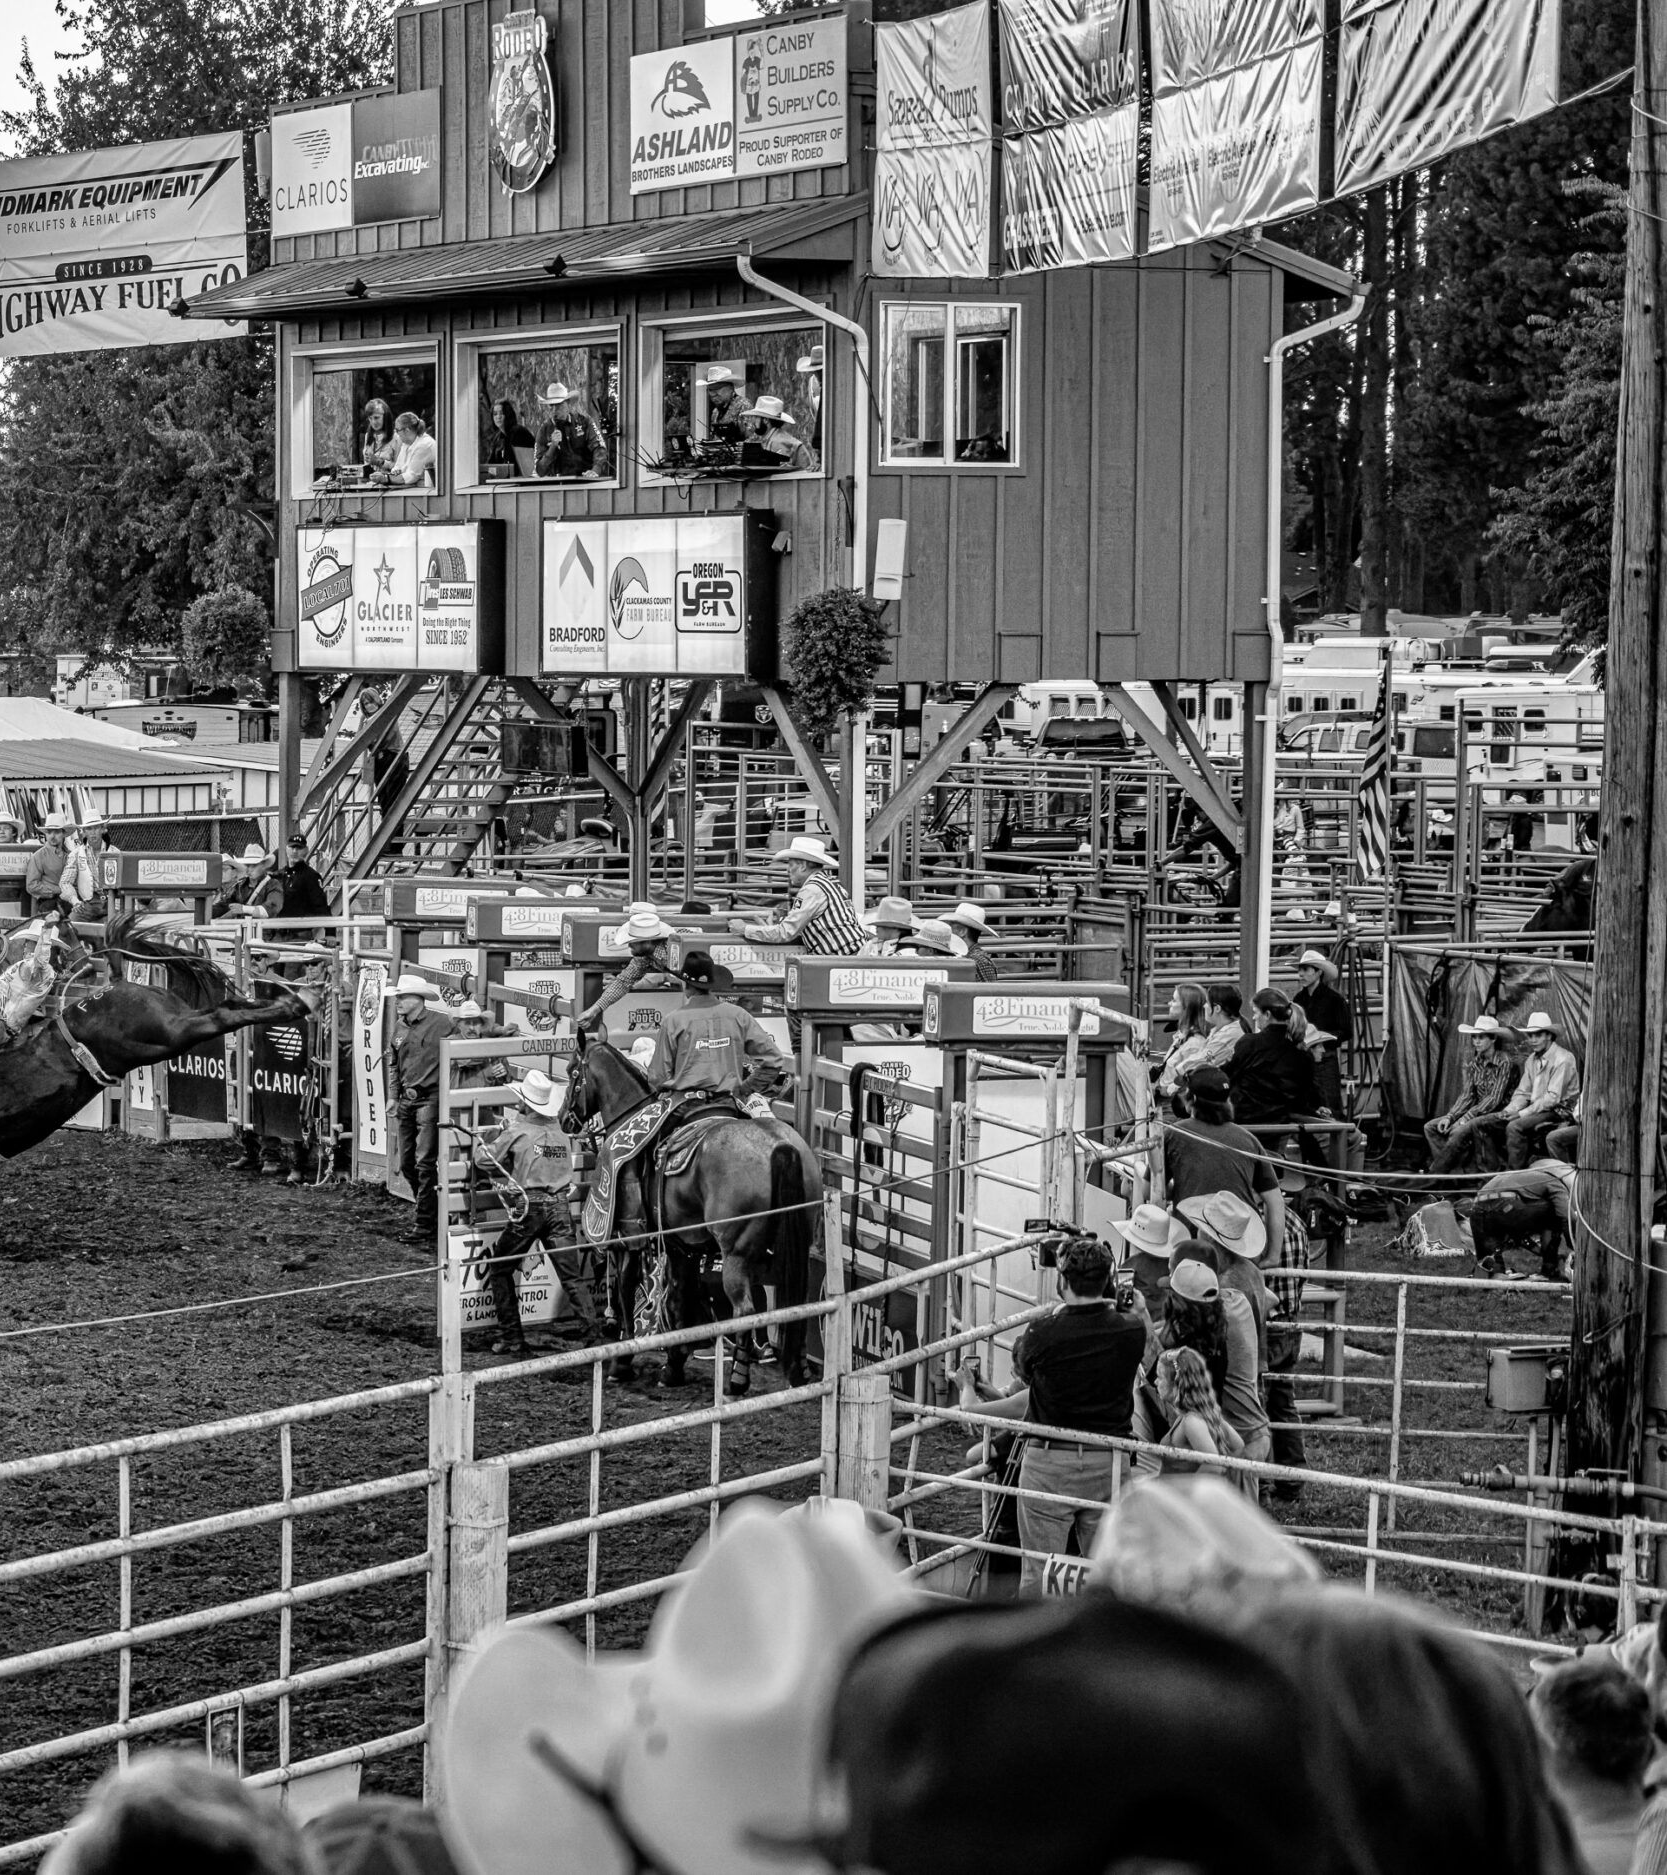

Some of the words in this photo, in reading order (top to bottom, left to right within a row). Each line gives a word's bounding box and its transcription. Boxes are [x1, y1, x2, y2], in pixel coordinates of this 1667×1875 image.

[492, 16, 546, 63] RODEO
[767, 32, 815, 55] CANBY
[767, 60, 835, 86] BUILDERS
[768, 95, 814, 116] SUPPLY
[817, 89, 841, 108] CO.
[632, 121, 733, 164] ASHLAND
[739, 136, 770, 154] PROUD
[773, 129, 827, 150] SUPPORTER
[830, 128, 843, 140] OF
[354, 153, 423, 179] Excavating
[632, 164, 675, 182] BROTHERS
[677, 155, 733, 175] LANDSCAPES
[757, 152, 789, 166] CANBY
[792, 147, 823, 162] RODEO
[78, 173, 204, 210] EQUIPMENT
[275, 178, 348, 211] CLARIOS
[7, 217, 65, 235] FORKLIFTS
[70, 217, 77, 228] &
[82, 212, 121, 227] AERIAL
[125, 209, 157, 223] LIFTS
[64, 263, 103, 278] SINCE
[112, 258, 144, 274] 1928
[306, 545, 339, 577] OPERATING
[692, 563, 724, 578] OREGON
[303, 586, 334, 610] LOCAL
[334, 575, 351, 596] 701
[440, 588, 448, 599] LES
[449, 588, 473, 599] SCHWAB
[626, 597, 653, 605] CLACKAMAS
[654, 597, 672, 605] COUNTY
[357, 601, 413, 621] GLACIER
[423, 618, 436, 628] Doing
[436, 618, 444, 627] the
[445, 618, 457, 629] Right
[458, 618, 471, 629] Thing
[626, 608, 643, 622] FARM
[646, 608, 672, 622] BUREAU
[315, 617, 348, 648] ENGINEERS
[426, 630, 448, 645] SINCE
[450, 630, 468, 645] 1952
[549, 627, 605, 643] BRADFORD
[442, 961, 472, 973] RODEO
[529, 982, 561, 995] RODEO
[629, 1010, 662, 1023] RODEO
[522, 1038, 558, 1053] CANBY
[169, 1055, 225, 1080] CLARIOS
[364, 1029, 376, 1146] RODEO
[521, 1304, 537, 1315] INC.
[852, 1303, 904, 1360] Wilco
[1047, 1561, 1091, 1596] KEE
